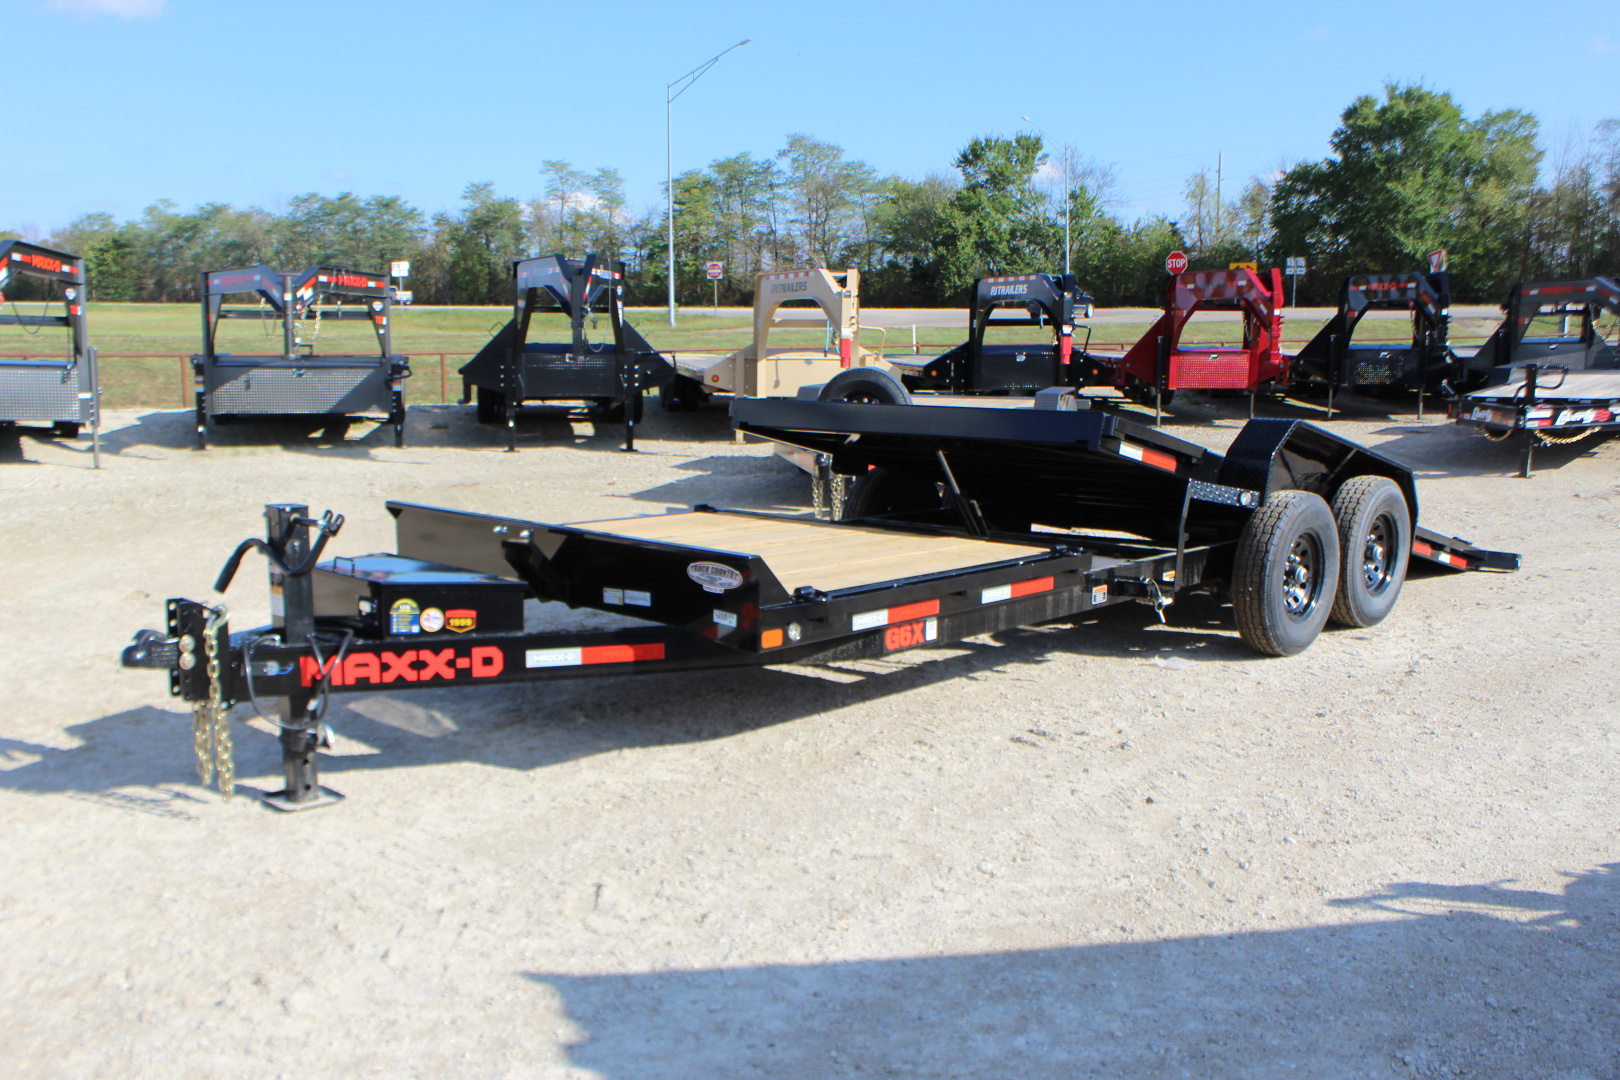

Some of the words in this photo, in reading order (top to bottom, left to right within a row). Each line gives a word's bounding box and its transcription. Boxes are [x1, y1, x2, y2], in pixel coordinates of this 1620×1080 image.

[1167, 259, 1186, 269] STOP
[689, 564, 710, 575] TRUCK
[710, 565, 739, 581] COUNTRY
[885, 620, 926, 651] G6X
[299, 646, 504, 688] MAXX-D
